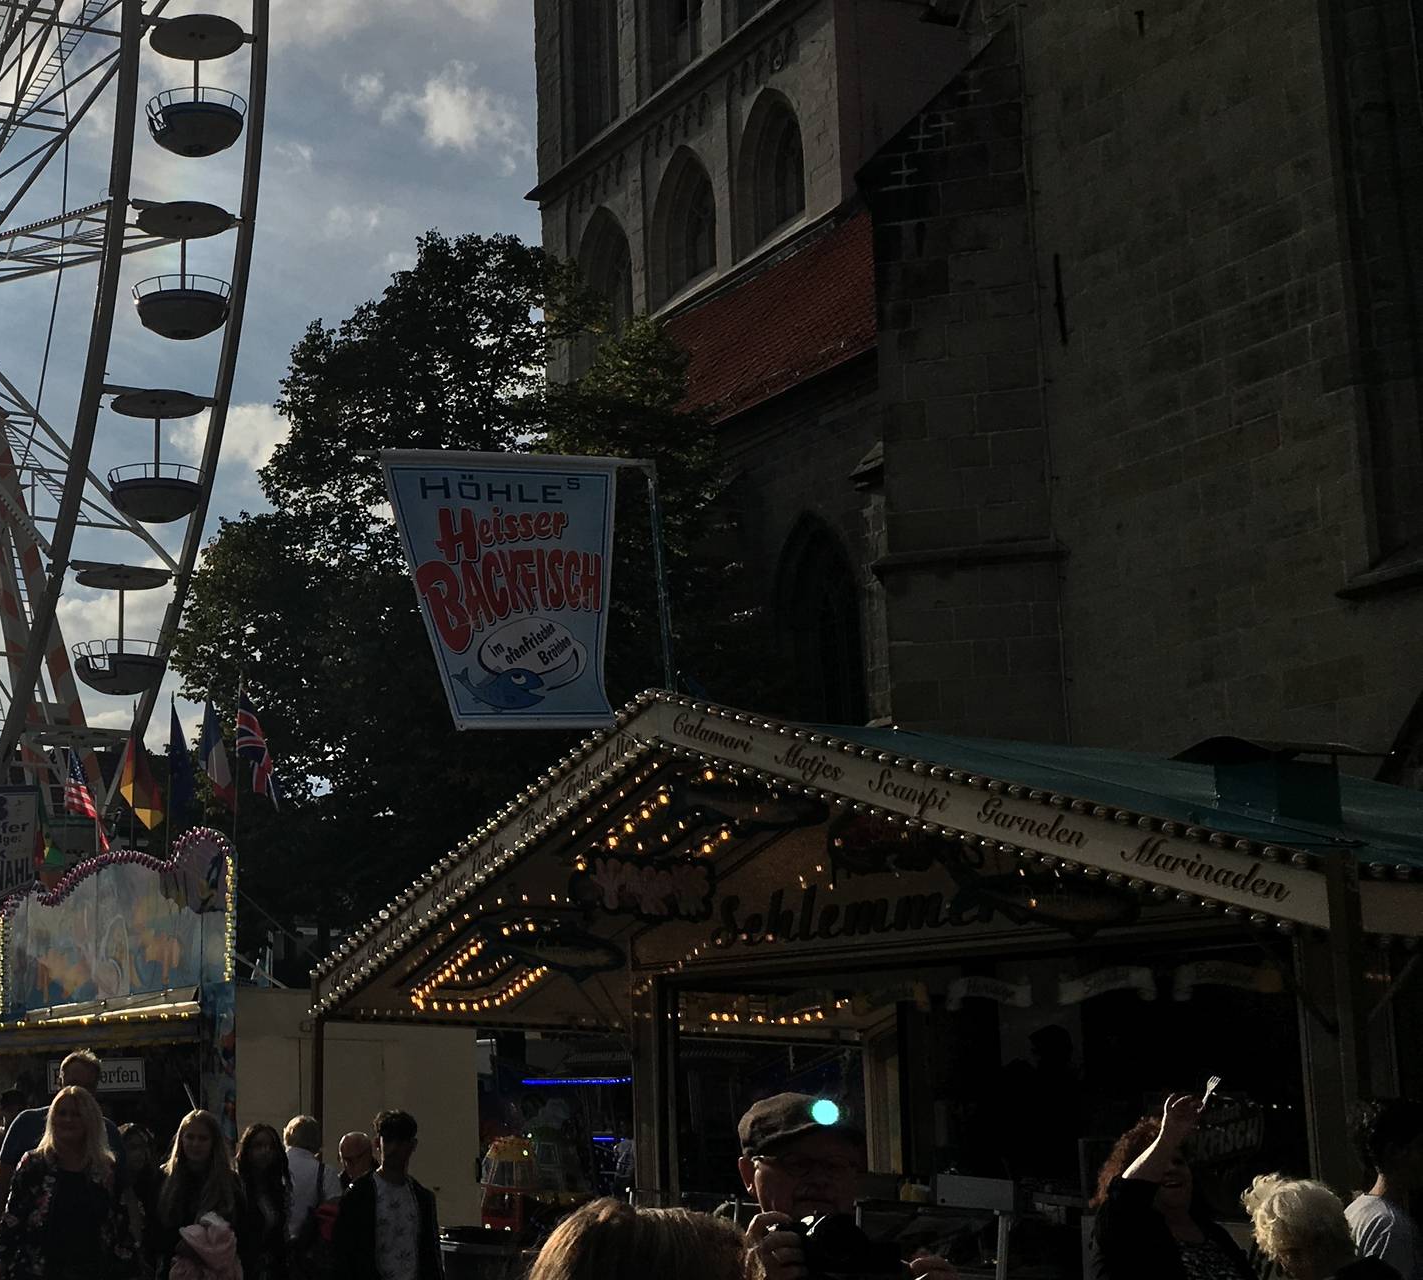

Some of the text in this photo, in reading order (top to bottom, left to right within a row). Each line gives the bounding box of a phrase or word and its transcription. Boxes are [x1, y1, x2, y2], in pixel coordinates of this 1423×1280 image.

[434, 506, 569, 564] Heisser
[415, 549, 603, 655] BACKFISCH
[487, 643, 505, 658] im
[505, 623, 556, 665] ofenfrischen
[537, 636, 572, 666] Brötchen
[673, 712, 753, 754] Calamari
[774, 743, 842, 782] Matjes
[868, 768, 953, 817] Scampi
[976, 797, 1088, 849] Garnelen
[1120, 835, 1292, 903] Marinaden
